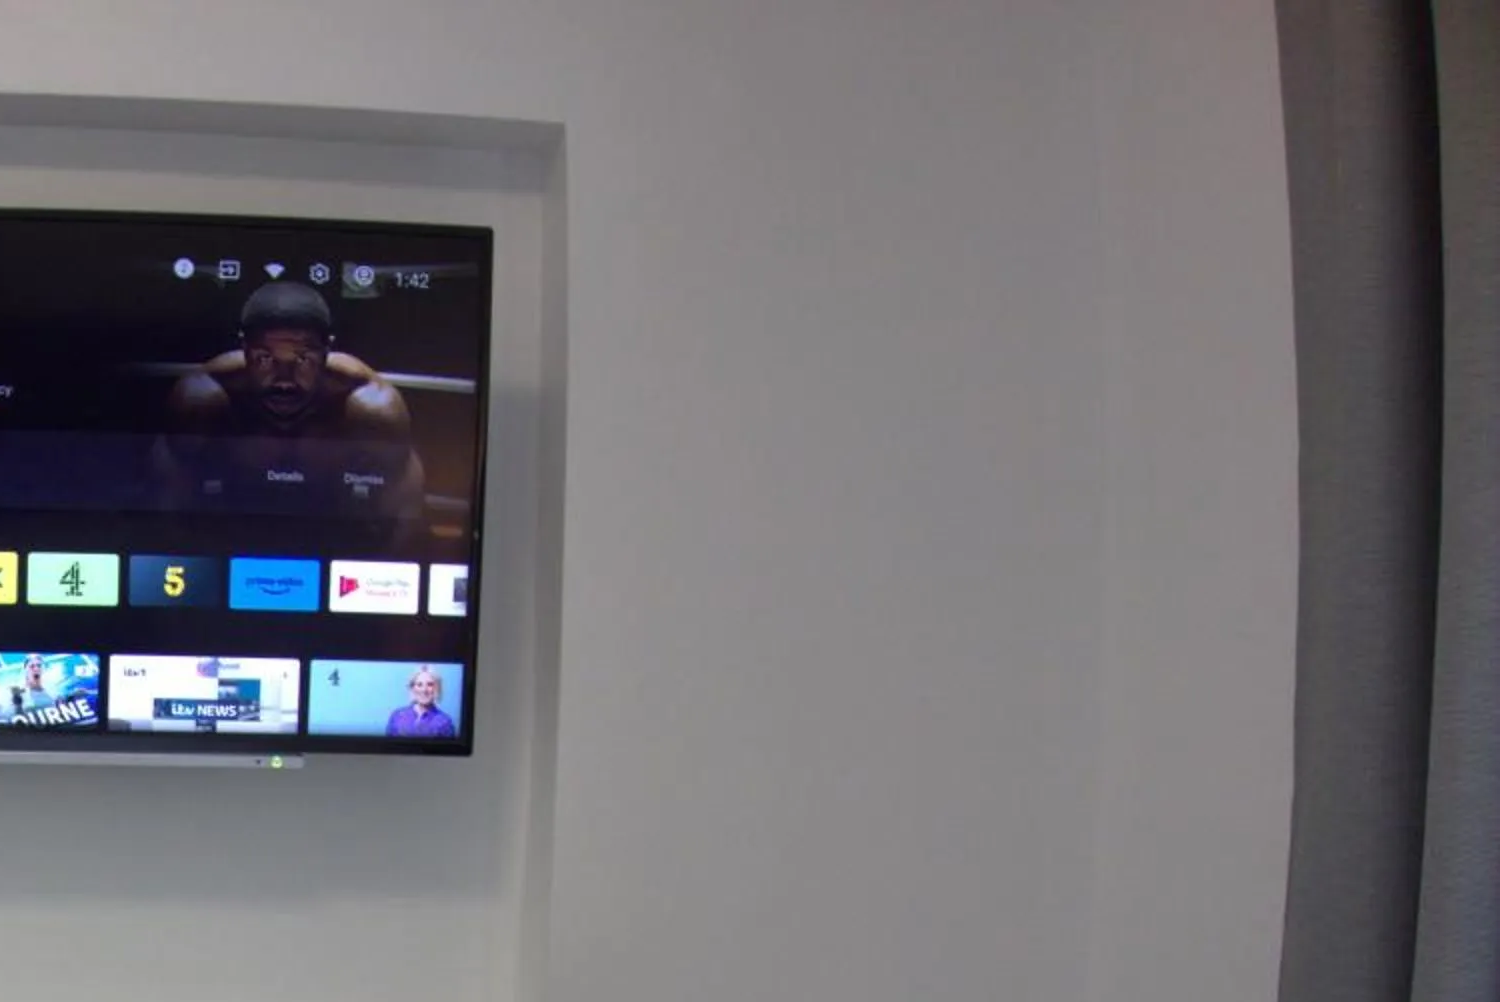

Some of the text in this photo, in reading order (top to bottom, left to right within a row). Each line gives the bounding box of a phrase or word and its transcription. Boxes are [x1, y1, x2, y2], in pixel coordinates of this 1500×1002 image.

[395, 271, 430, 289] 1:42
[59, 560, 86, 597] 4
[163, 565, 186, 598] 5
[328, 668, 340, 686] 4
[197, 705, 238, 717] NEWS
